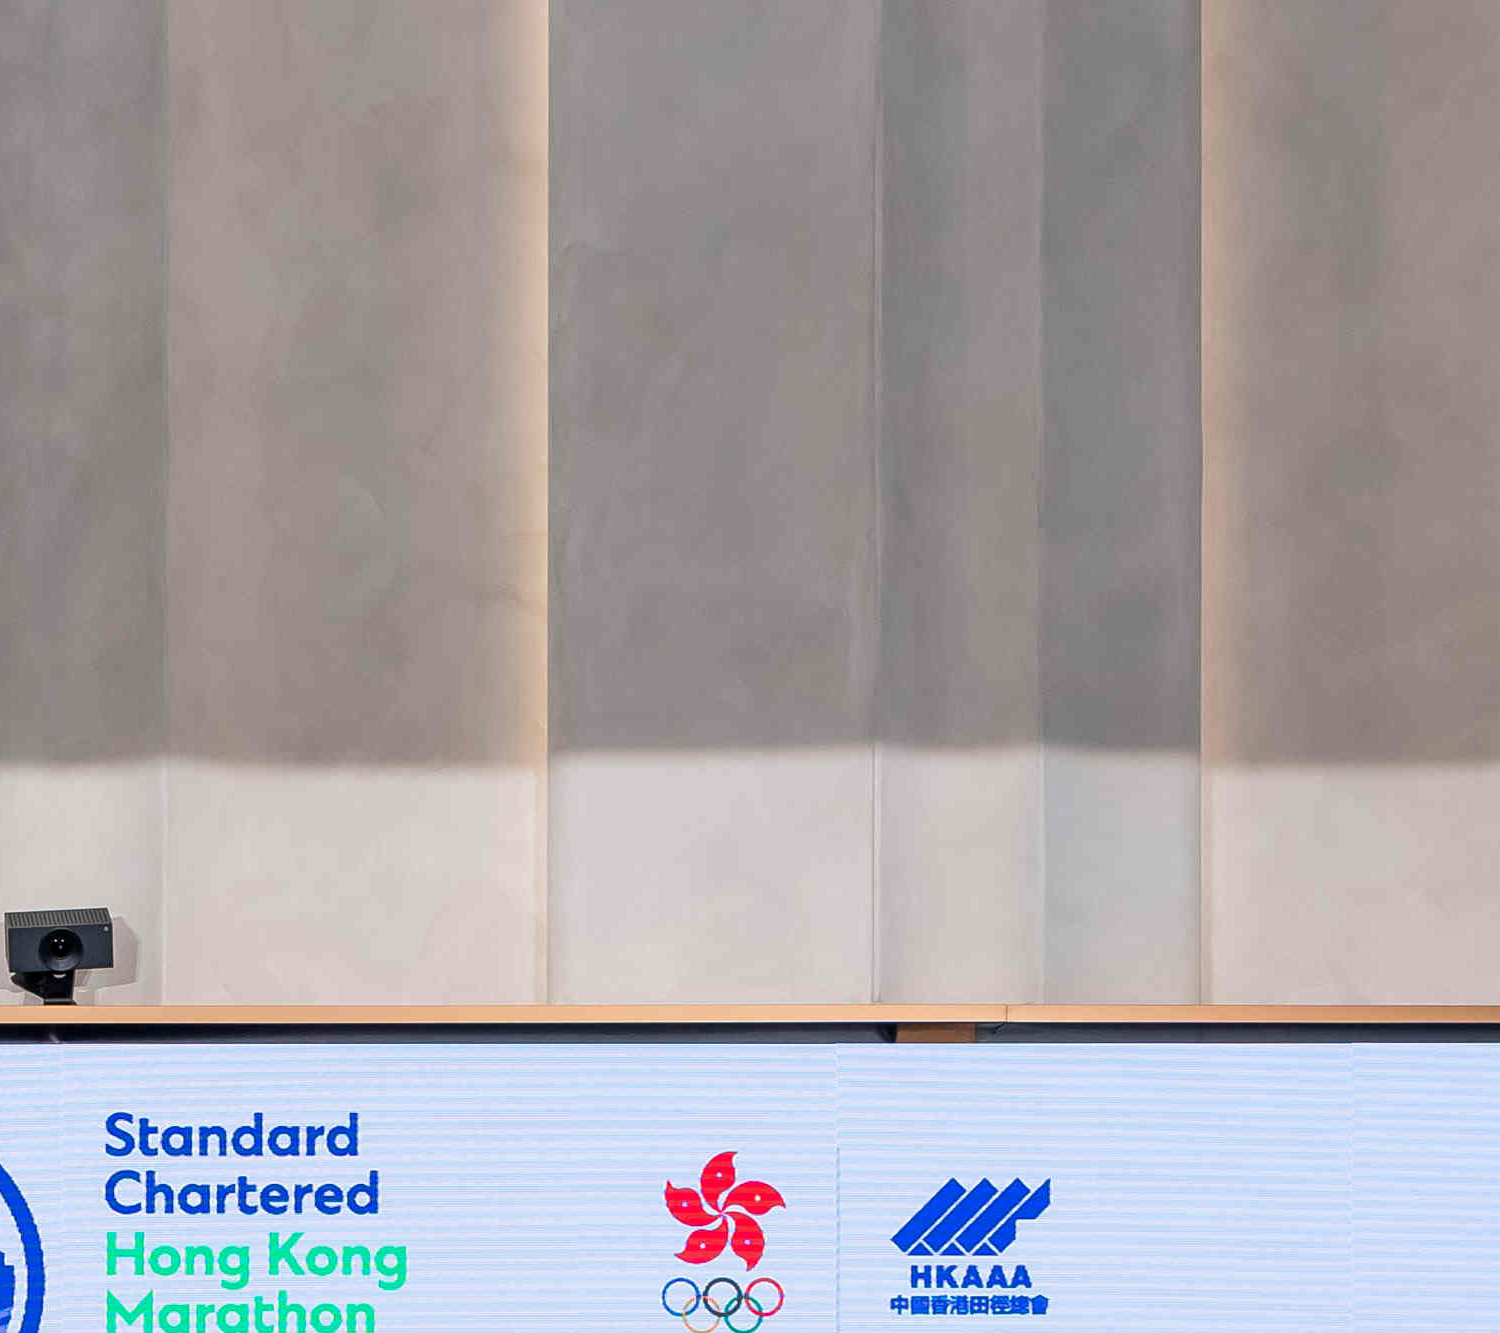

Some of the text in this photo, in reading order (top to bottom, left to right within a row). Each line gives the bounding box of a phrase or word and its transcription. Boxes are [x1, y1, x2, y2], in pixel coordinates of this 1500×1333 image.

[104, 1112, 359, 1158] Standard
[104, 1170, 380, 1216] Chartered
[105, 1231, 409, 1291] Hong Kong
[910, 1264, 1033, 1289] HKAAA
